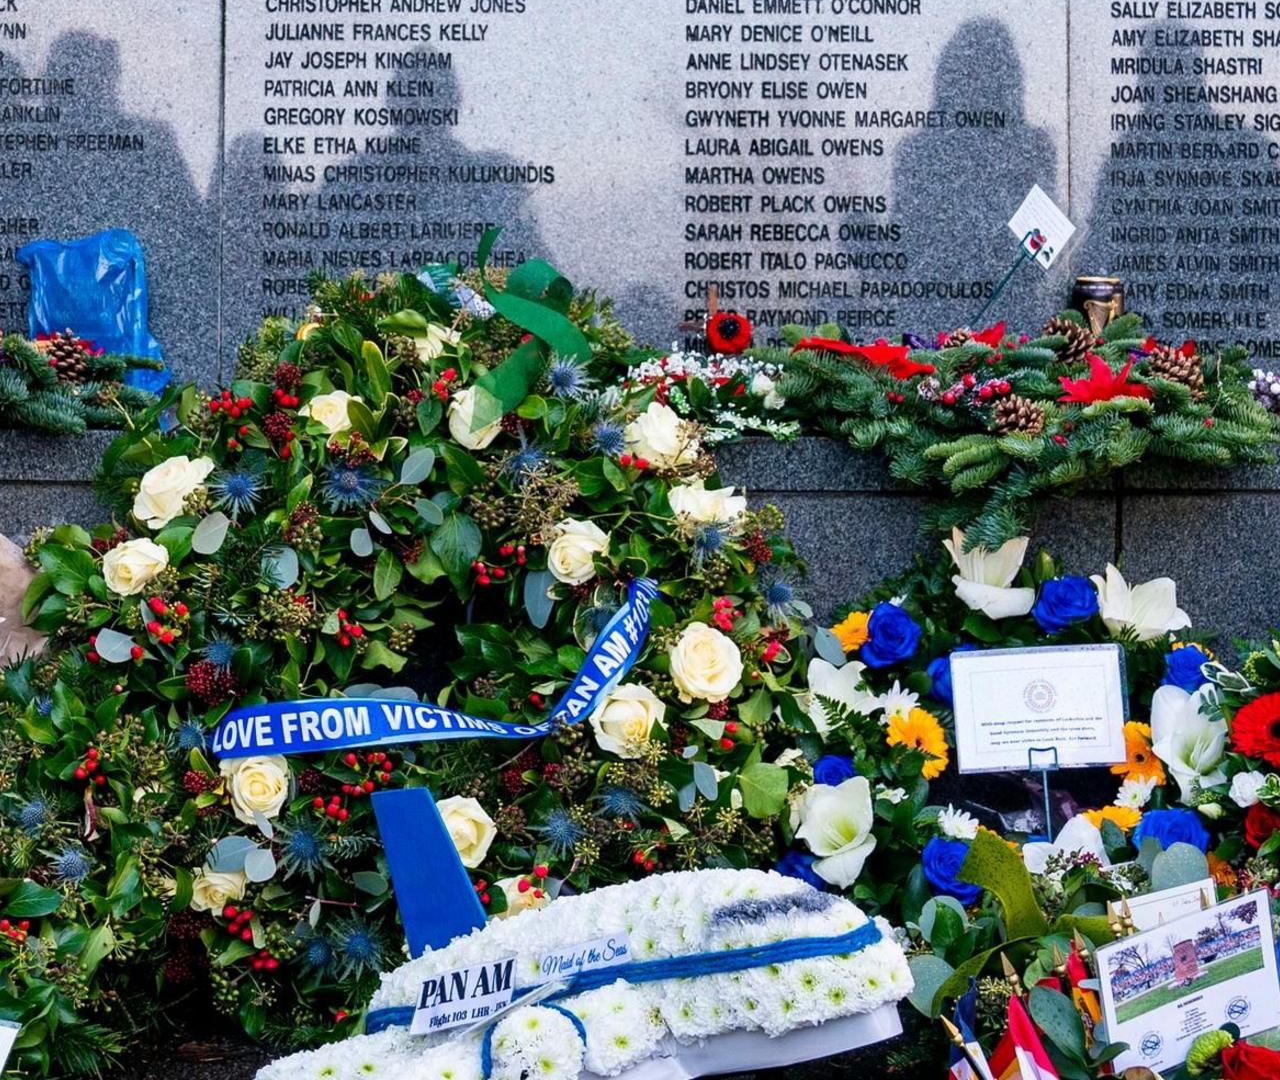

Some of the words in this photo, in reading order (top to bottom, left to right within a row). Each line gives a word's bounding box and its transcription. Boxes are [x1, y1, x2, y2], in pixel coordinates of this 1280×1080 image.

[685, 80, 754, 100] BRYONY
[761, 80, 808, 101] ELISE
[816, 81, 867, 100] OWEN
[684, 194, 753, 214] ROBERT
[760, 195, 815, 214] PLACK
[823, 195, 887, 215] OWENS
[211, 715, 274, 753] LOVE
[281, 706, 371, 743] FROM
[380, 704, 507, 735] VICTIMS
[513, 721, 552, 736] OF
[593, 630, 632, 678] AM
[542, 955, 573, 976] Maid
[587, 948, 601, 964] the
[603, 938, 628, 962] Seas
[418, 970, 468, 1010] PAN
[471, 958, 515, 998] AM
[429, 1008, 451, 1029] Flight
[452, 1011, 468, 1023] 103
[471, 1006, 490, 1019] LHR
